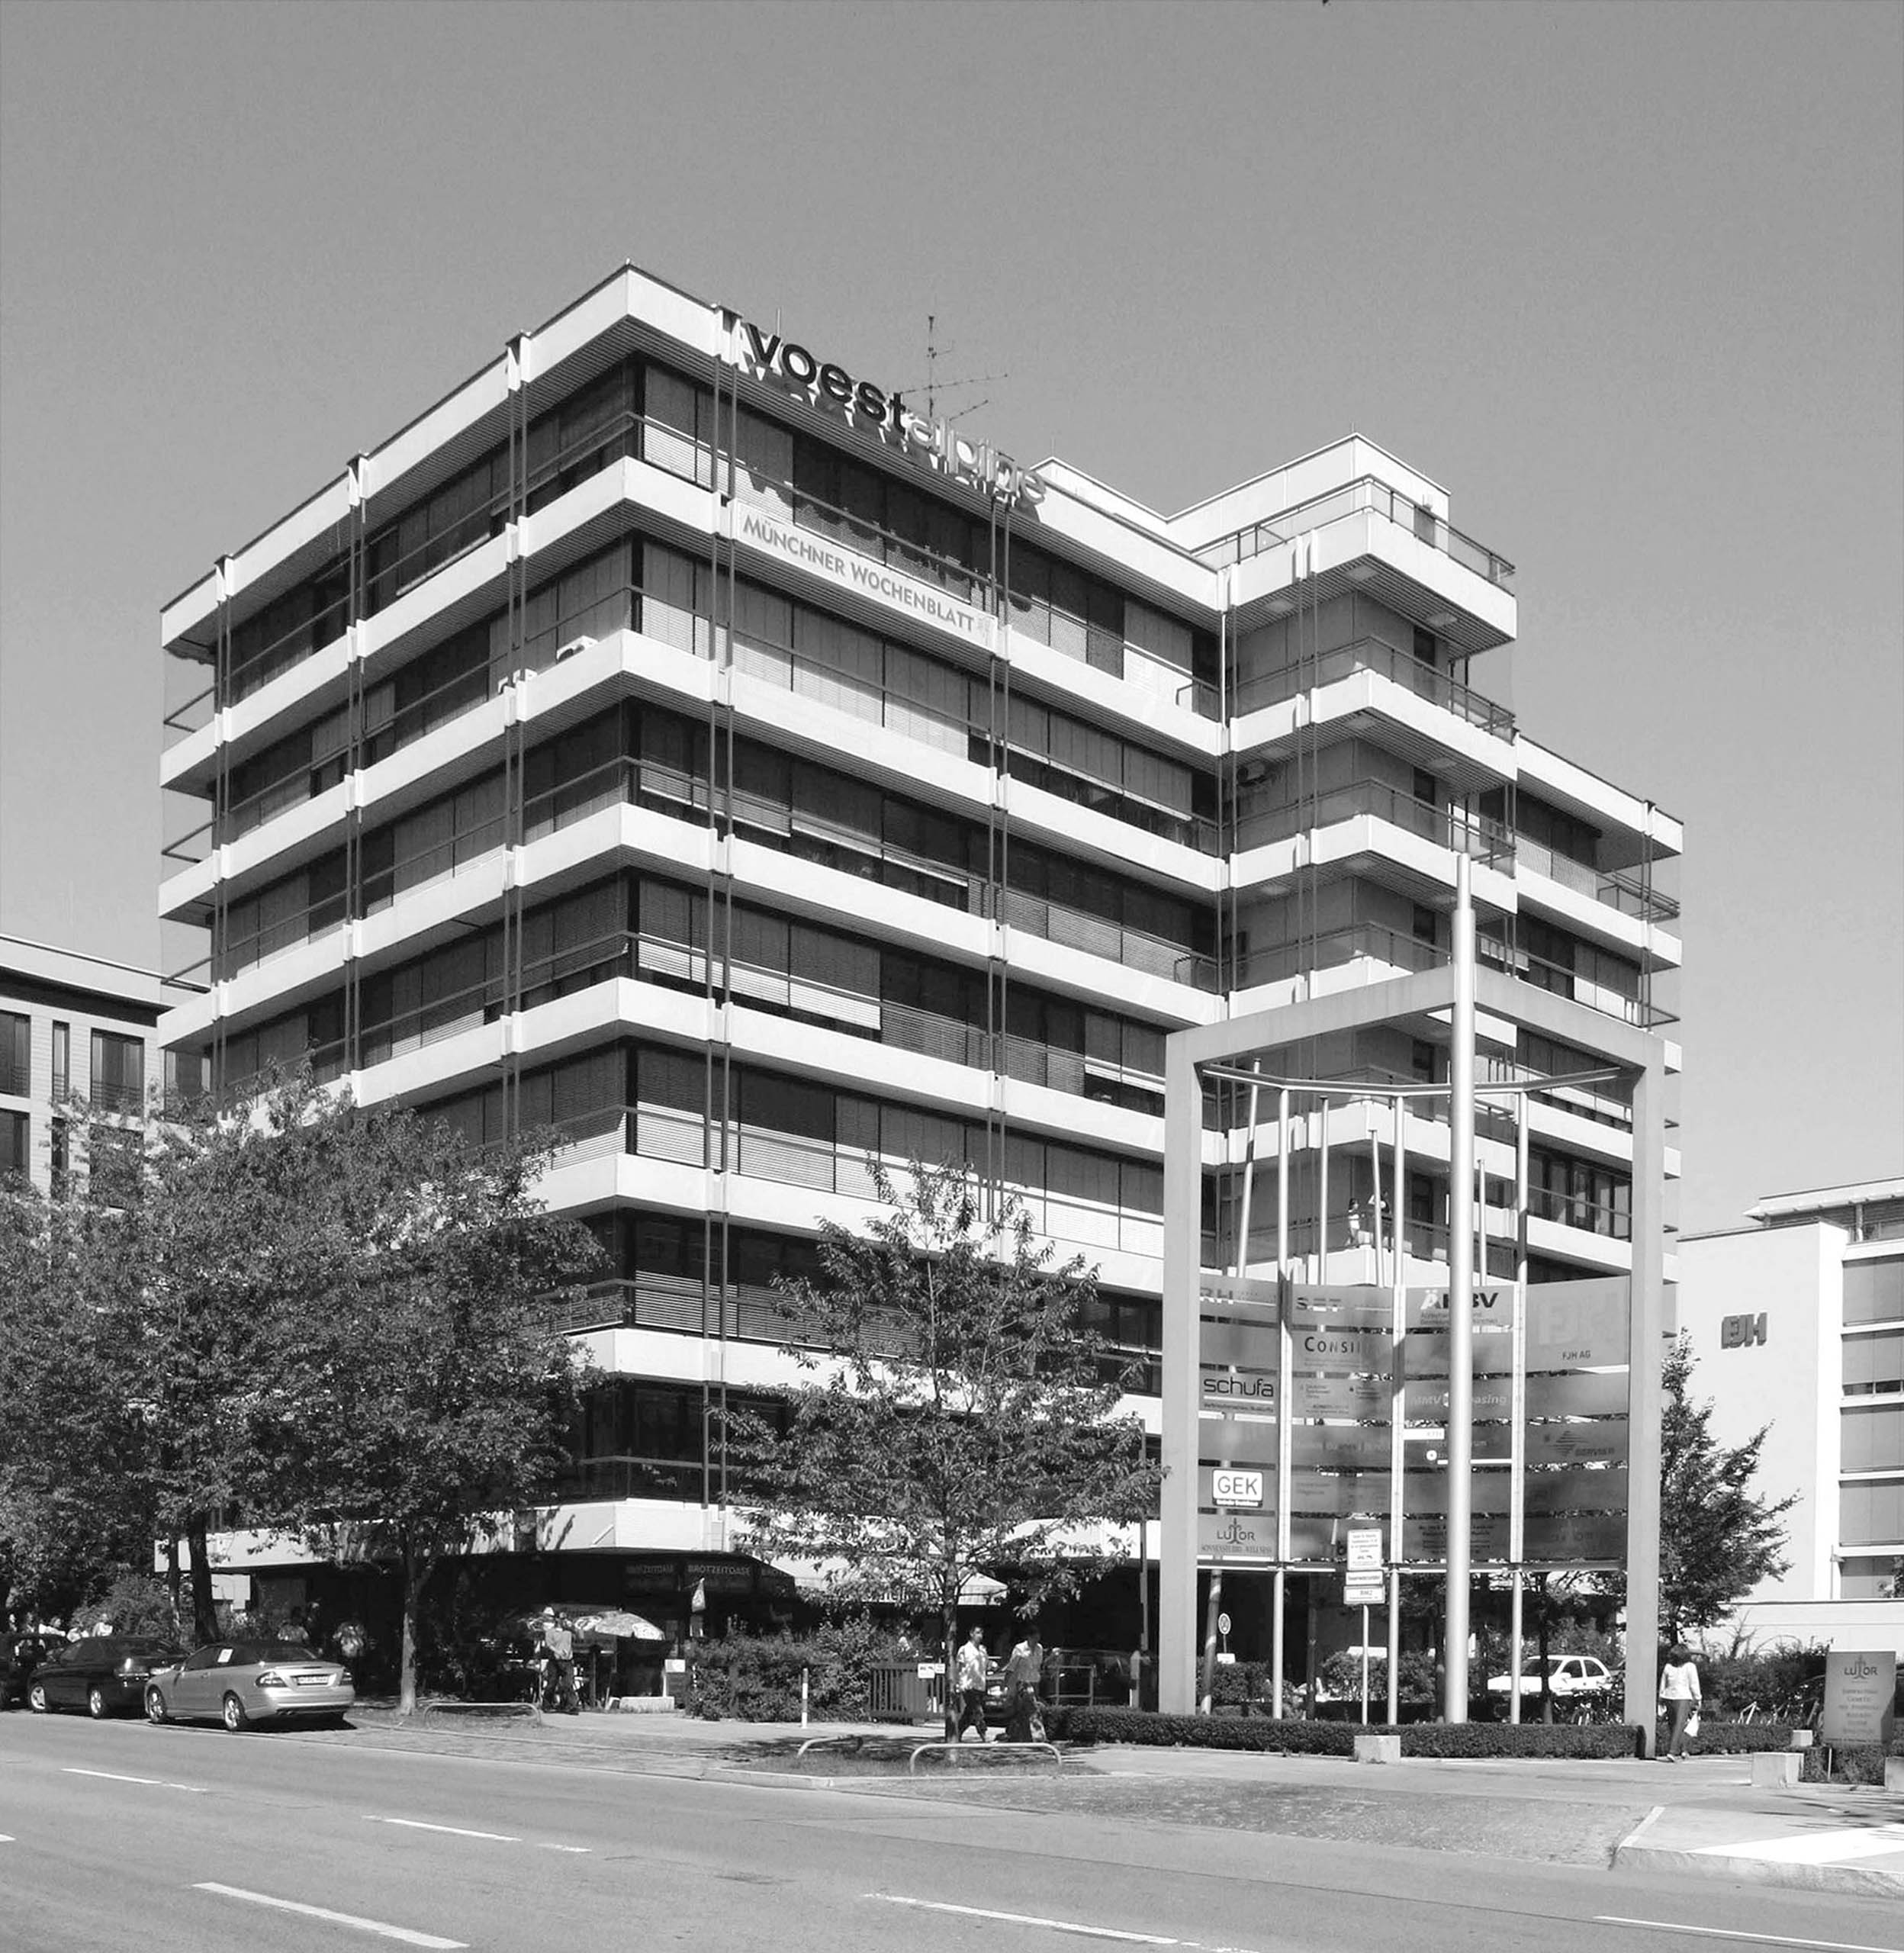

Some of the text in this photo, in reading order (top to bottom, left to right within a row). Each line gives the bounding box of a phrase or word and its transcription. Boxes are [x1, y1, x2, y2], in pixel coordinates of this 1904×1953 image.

[746, 322, 1046, 504] voestalpine
[742, 515, 975, 632] MÜNCHNER WOCHENBLATT
[1562, 1350, 1591, 1360] FJH AG
[1203, 1376, 1274, 1398] schufa
[1217, 1475, 1258, 1495] GEK
